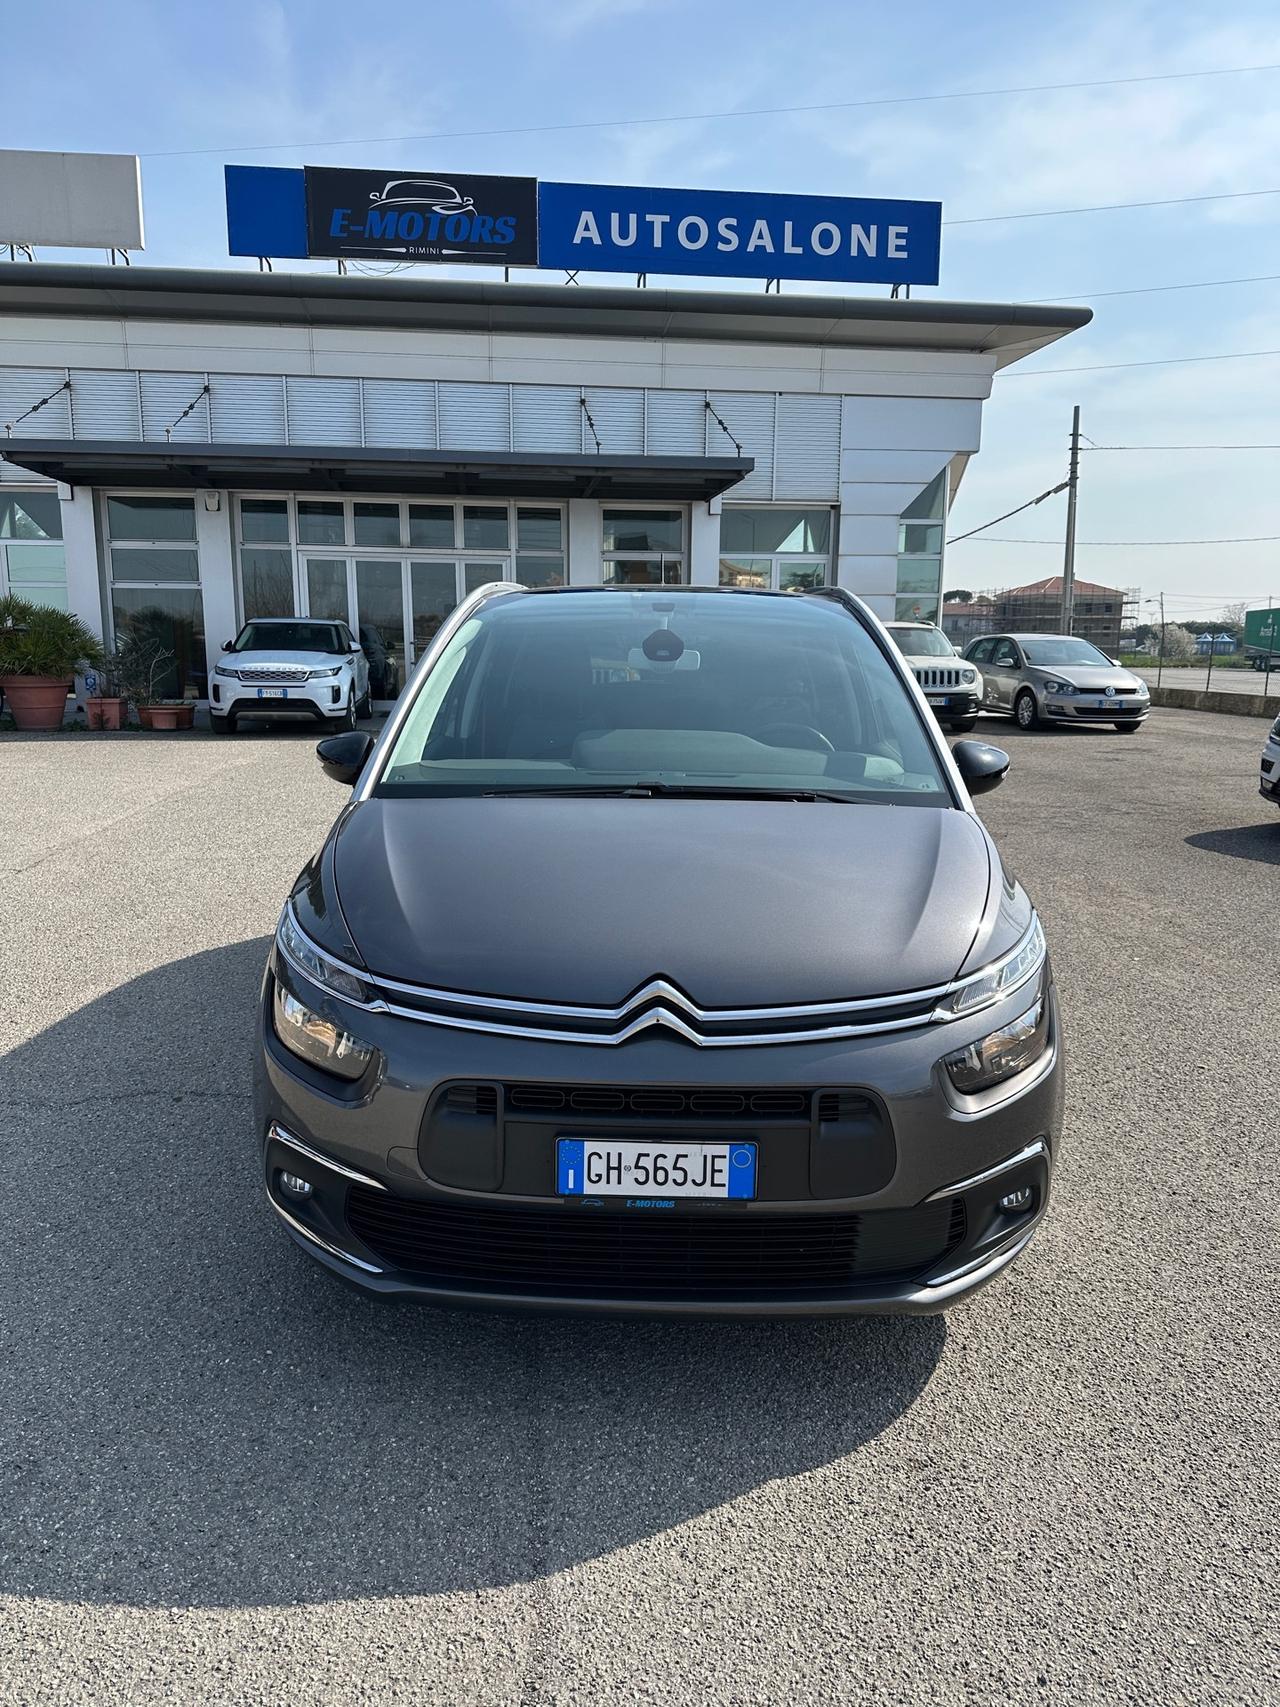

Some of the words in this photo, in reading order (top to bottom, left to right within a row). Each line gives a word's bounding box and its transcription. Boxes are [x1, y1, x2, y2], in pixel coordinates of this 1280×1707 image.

[329, 207, 518, 245] E-MOTORS
[572, 210, 909, 259] AUTOSALONE
[408, 246, 440, 255] RIMINI
[626, 1200, 676, 1209] E-MOTORS
